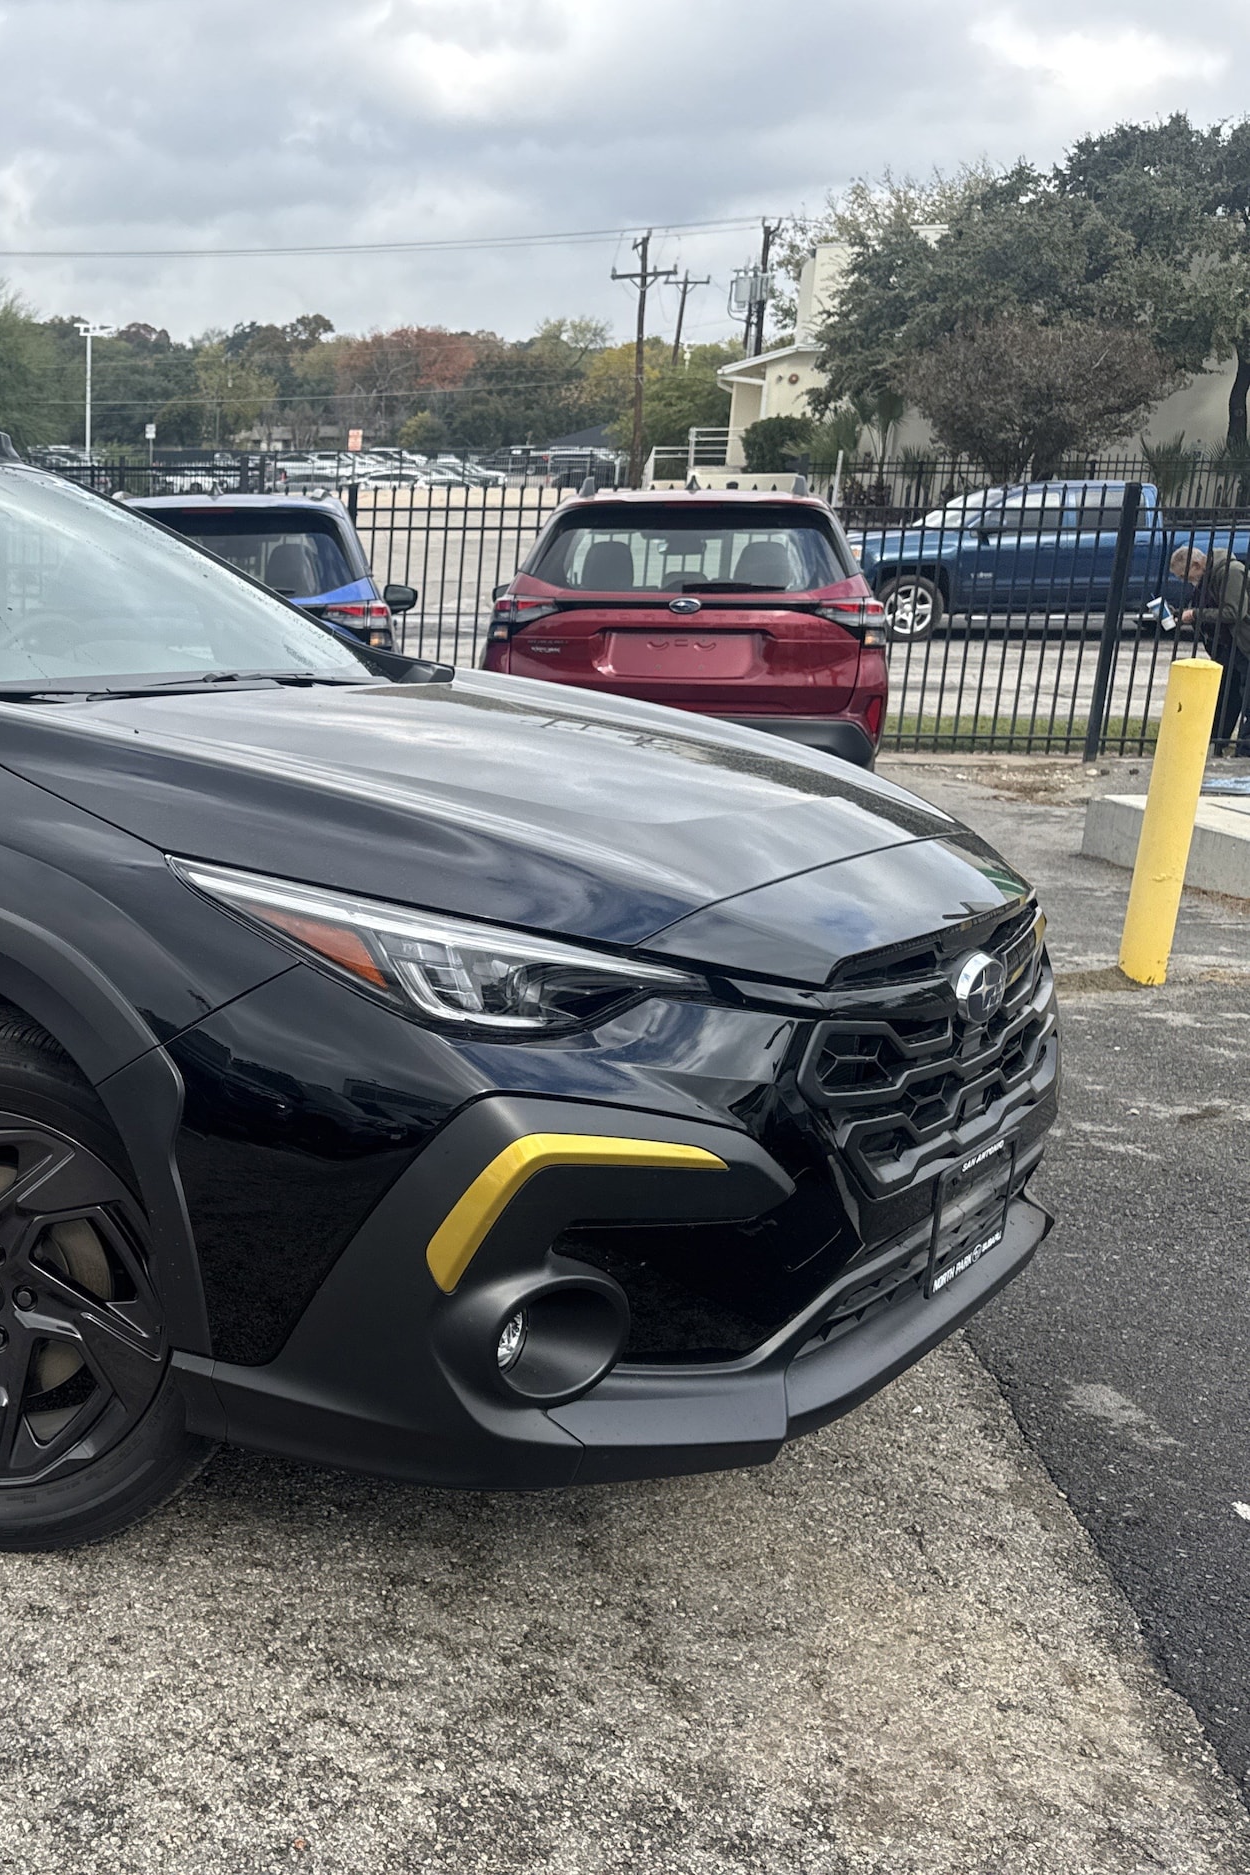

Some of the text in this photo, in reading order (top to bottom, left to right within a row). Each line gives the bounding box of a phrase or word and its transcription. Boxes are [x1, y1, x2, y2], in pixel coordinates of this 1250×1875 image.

[961, 1139, 1004, 1173] SAN ANTONIO
[932, 1230, 1002, 1293] NORTH PARK SUBARU
